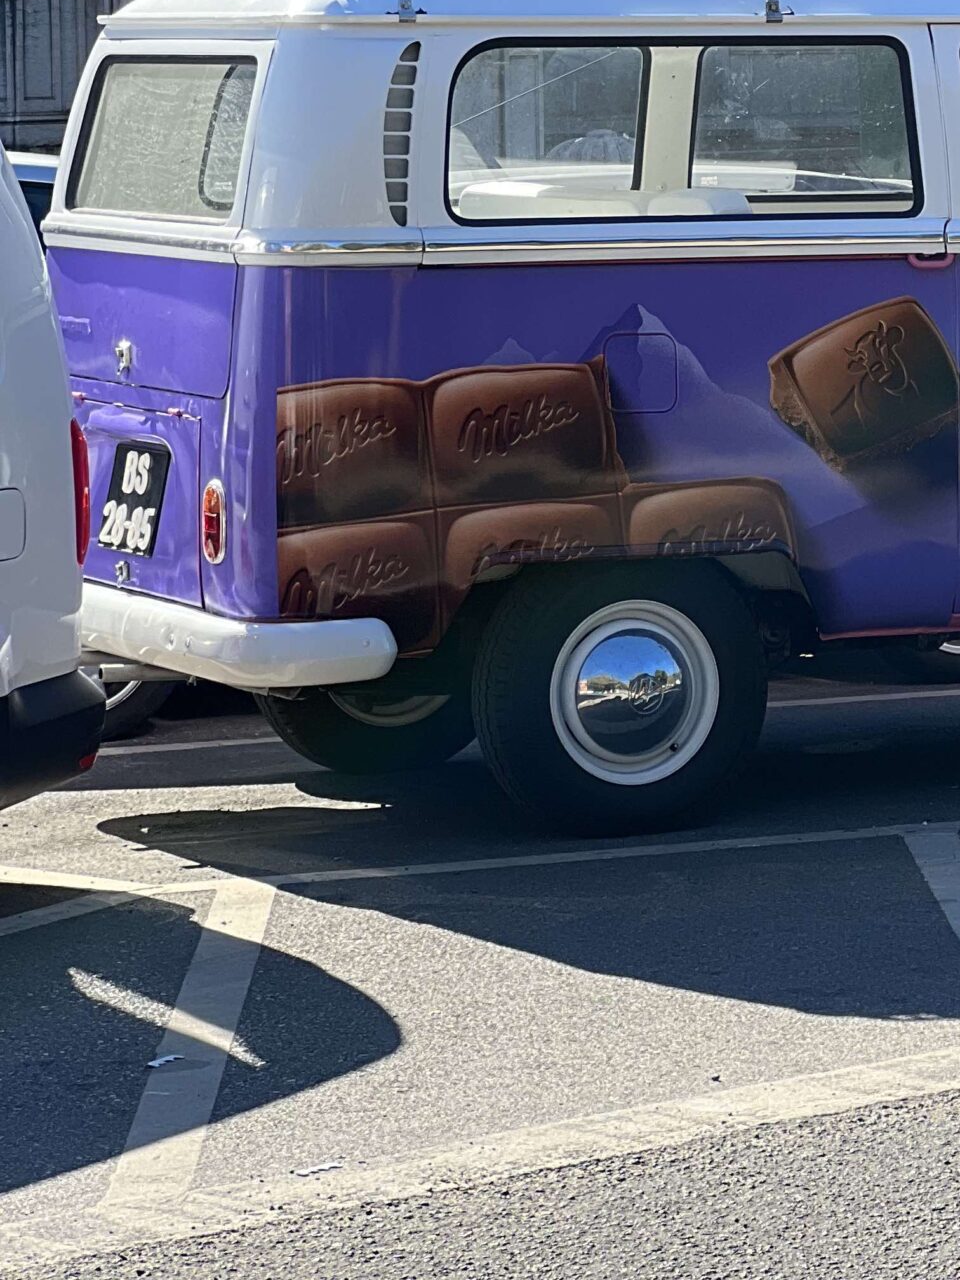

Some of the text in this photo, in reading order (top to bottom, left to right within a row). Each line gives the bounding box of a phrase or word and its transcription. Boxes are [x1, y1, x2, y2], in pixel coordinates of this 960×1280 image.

[457, 394, 580, 463] Milka
[122, 450, 151, 496] BS
[98, 500, 156, 551] 28-85
